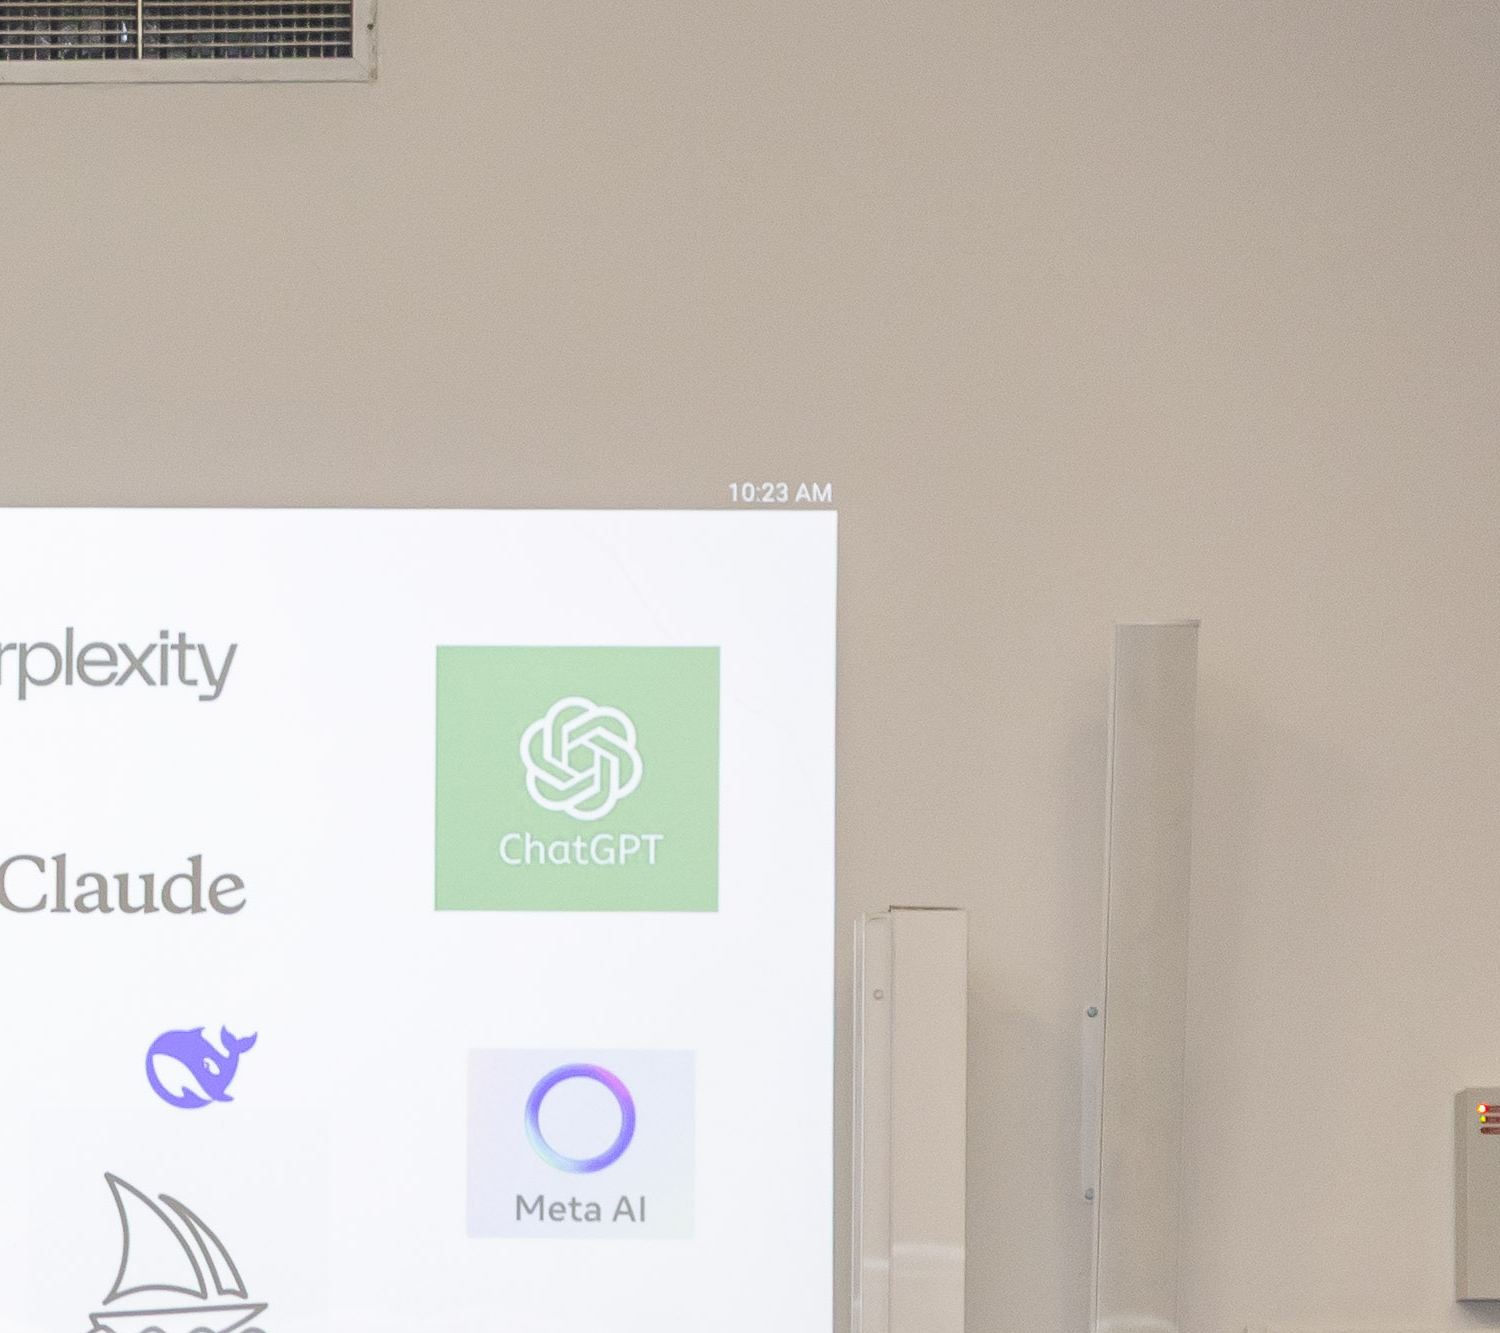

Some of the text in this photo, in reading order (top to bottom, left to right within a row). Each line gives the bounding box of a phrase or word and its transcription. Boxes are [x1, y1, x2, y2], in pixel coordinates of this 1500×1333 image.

[728, 482, 832, 503] 10:23 AM
[499, 832, 664, 866] ChatGPT
[515, 1194, 647, 1223] Meta AI
